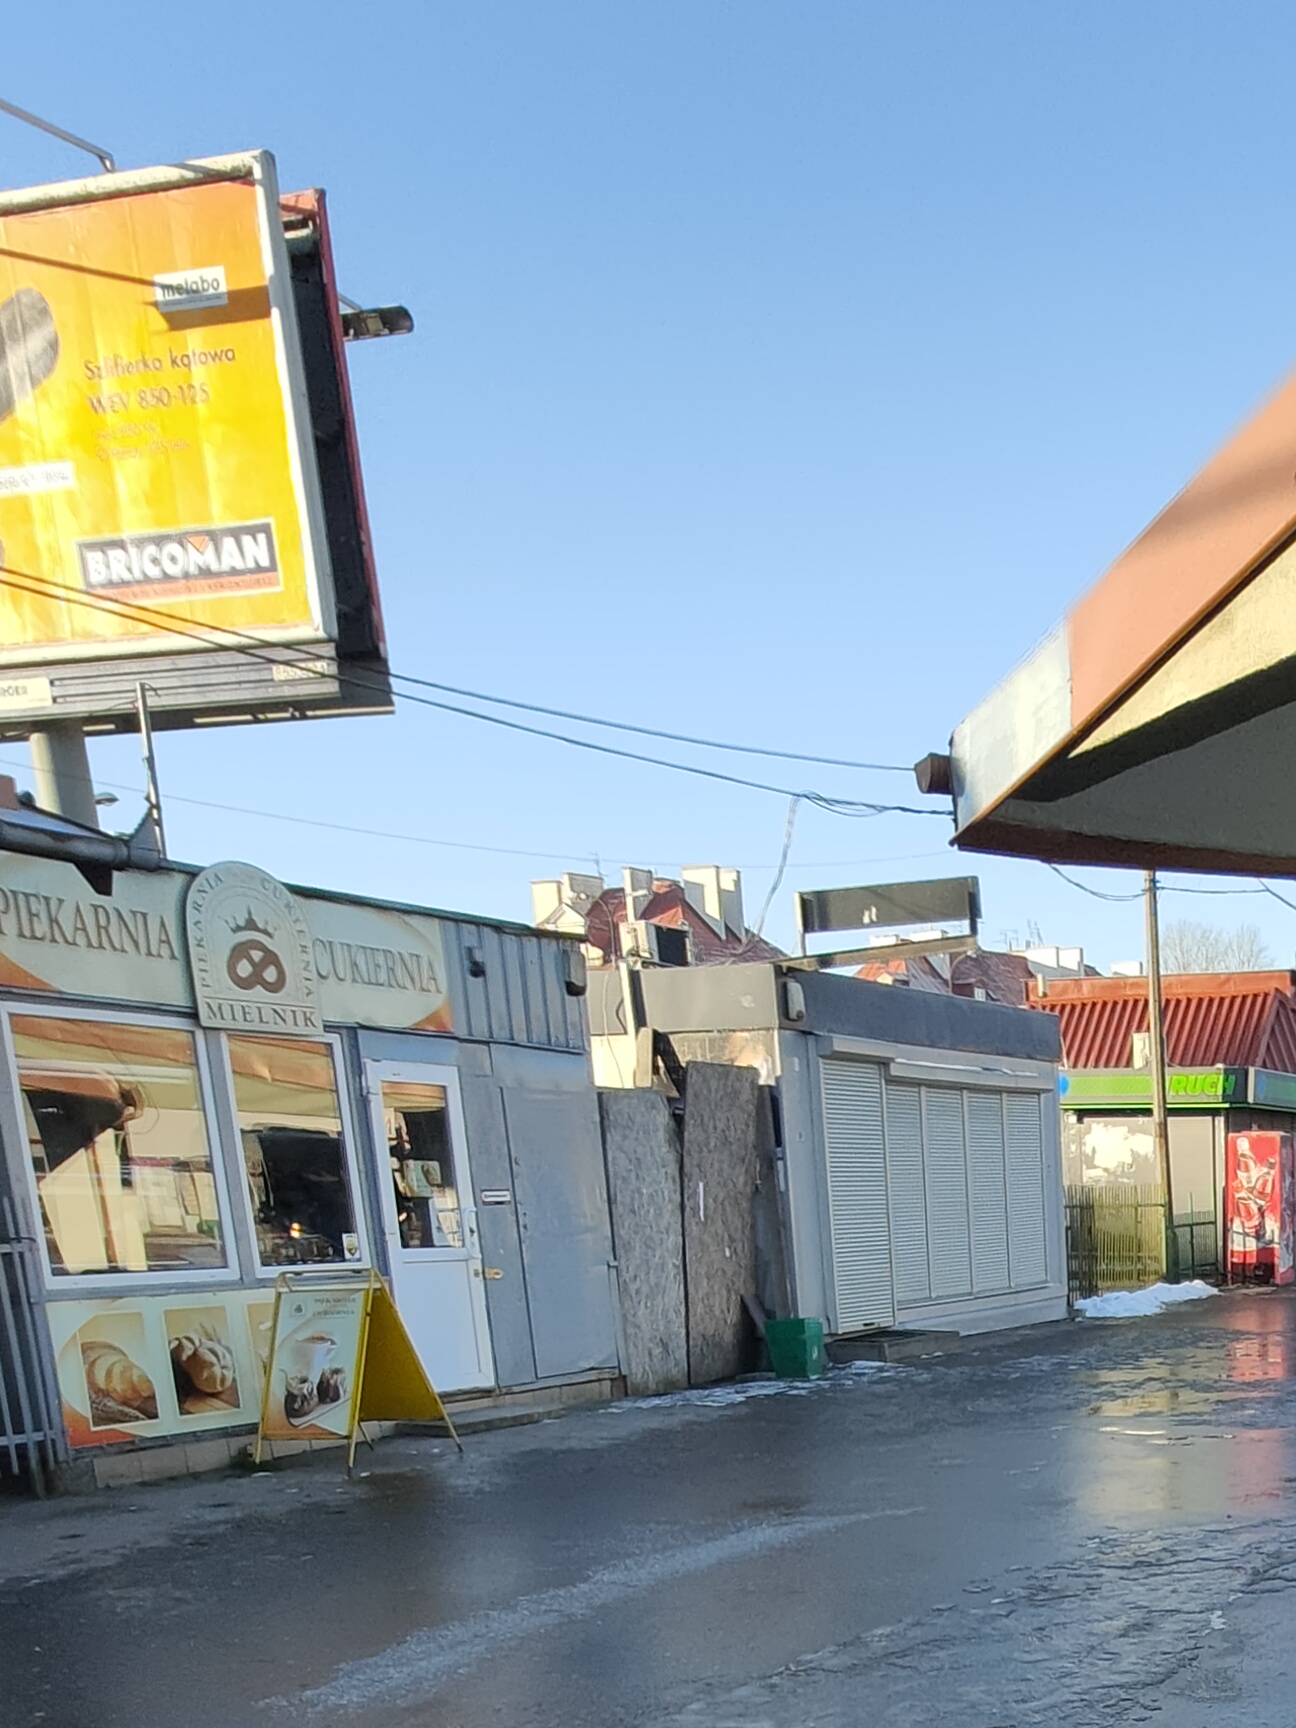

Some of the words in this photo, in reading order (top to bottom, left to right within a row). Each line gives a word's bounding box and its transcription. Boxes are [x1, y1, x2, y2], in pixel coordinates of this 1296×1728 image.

[86, 532, 271, 585] BRICOMAN
[0, 887, 179, 961] PIEKARNIA
[312, 937, 443, 994] CUKIERNIA
[205, 1001, 318, 1029] MIELNIK
[1169, 1073, 1235, 1096] RUCH
